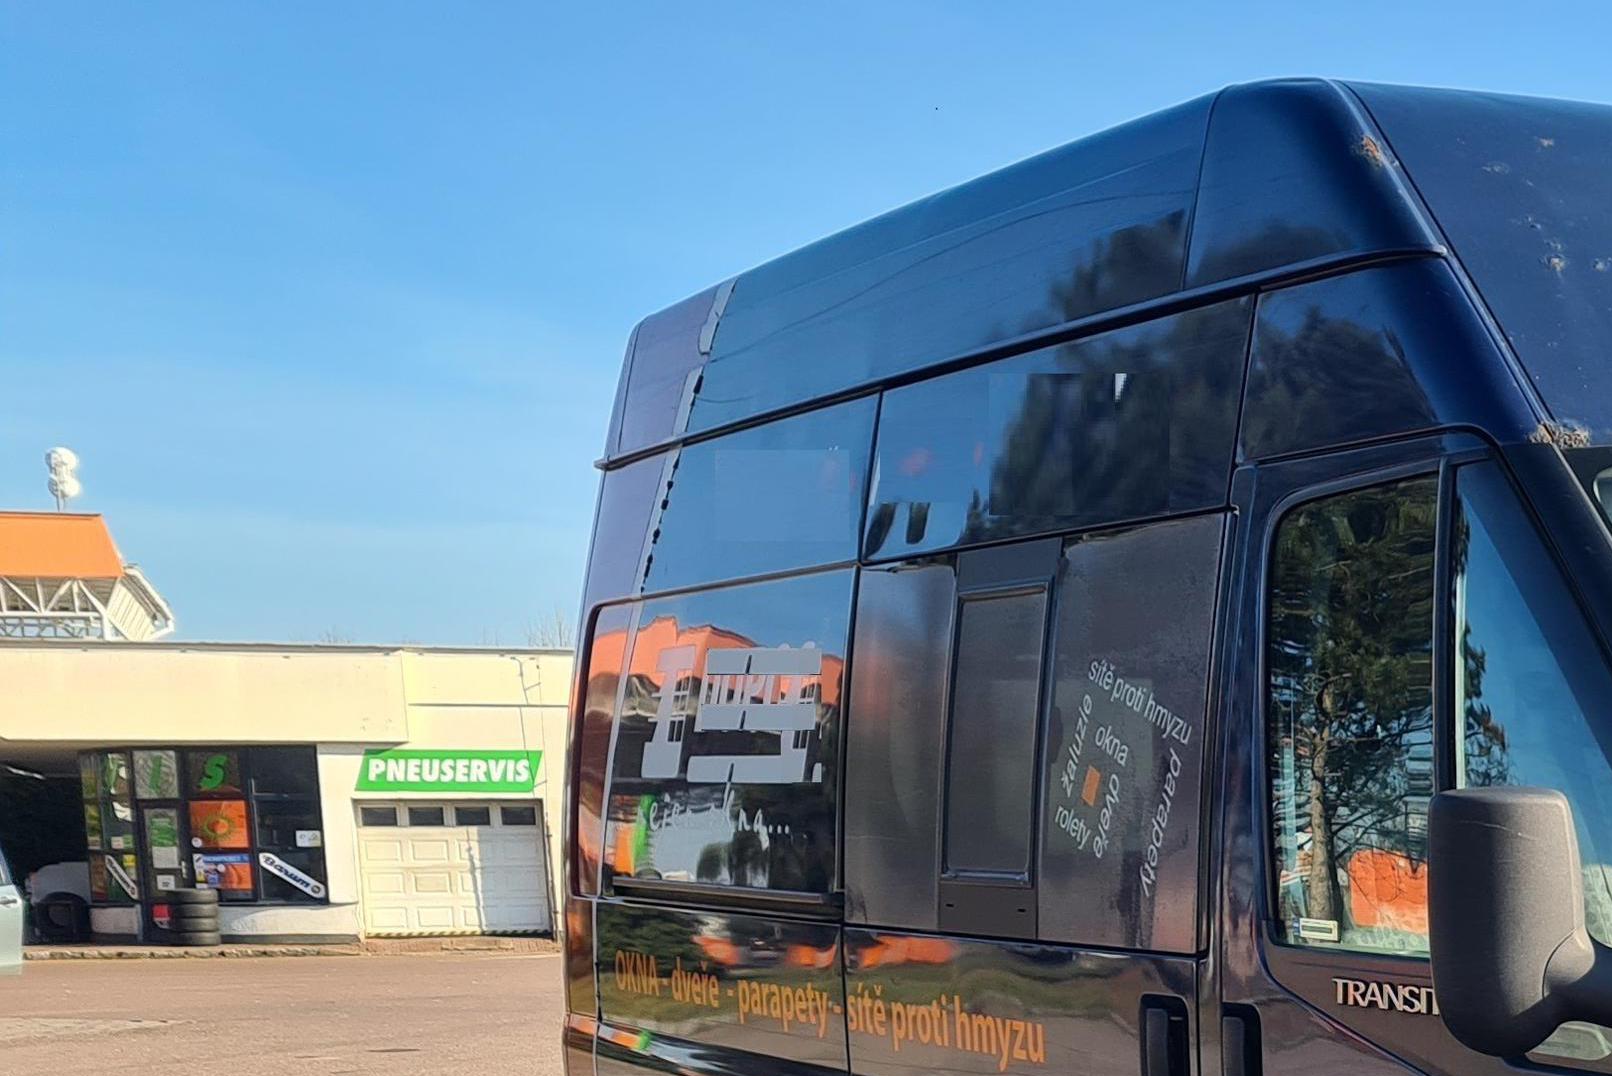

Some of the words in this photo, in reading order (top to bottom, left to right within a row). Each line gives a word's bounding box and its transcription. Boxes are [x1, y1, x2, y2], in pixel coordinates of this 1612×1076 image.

[1088, 660, 1115, 690] sítě
[1110, 678, 1147, 712] proti
[1144, 693, 1193, 745] hmyzu
[368, 758, 530, 783] PNEUSERVIS
[1061, 694, 1093, 798] žaluzie
[1095, 725, 1129, 767] okna
[1055, 804, 1091, 850] rolety
[1093, 774, 1121, 858] dveře
[1139, 747, 1182, 897] parapety
[261, 852, 311, 890] Barum
[615, 950, 660, 996] OKNA
[671, 956, 719, 1008] dveře
[738, 979, 828, 1038] parapety
[847, 983, 887, 1036] sítě
[891, 994, 949, 1051] proti
[954, 994, 1045, 1073] hmyzu
